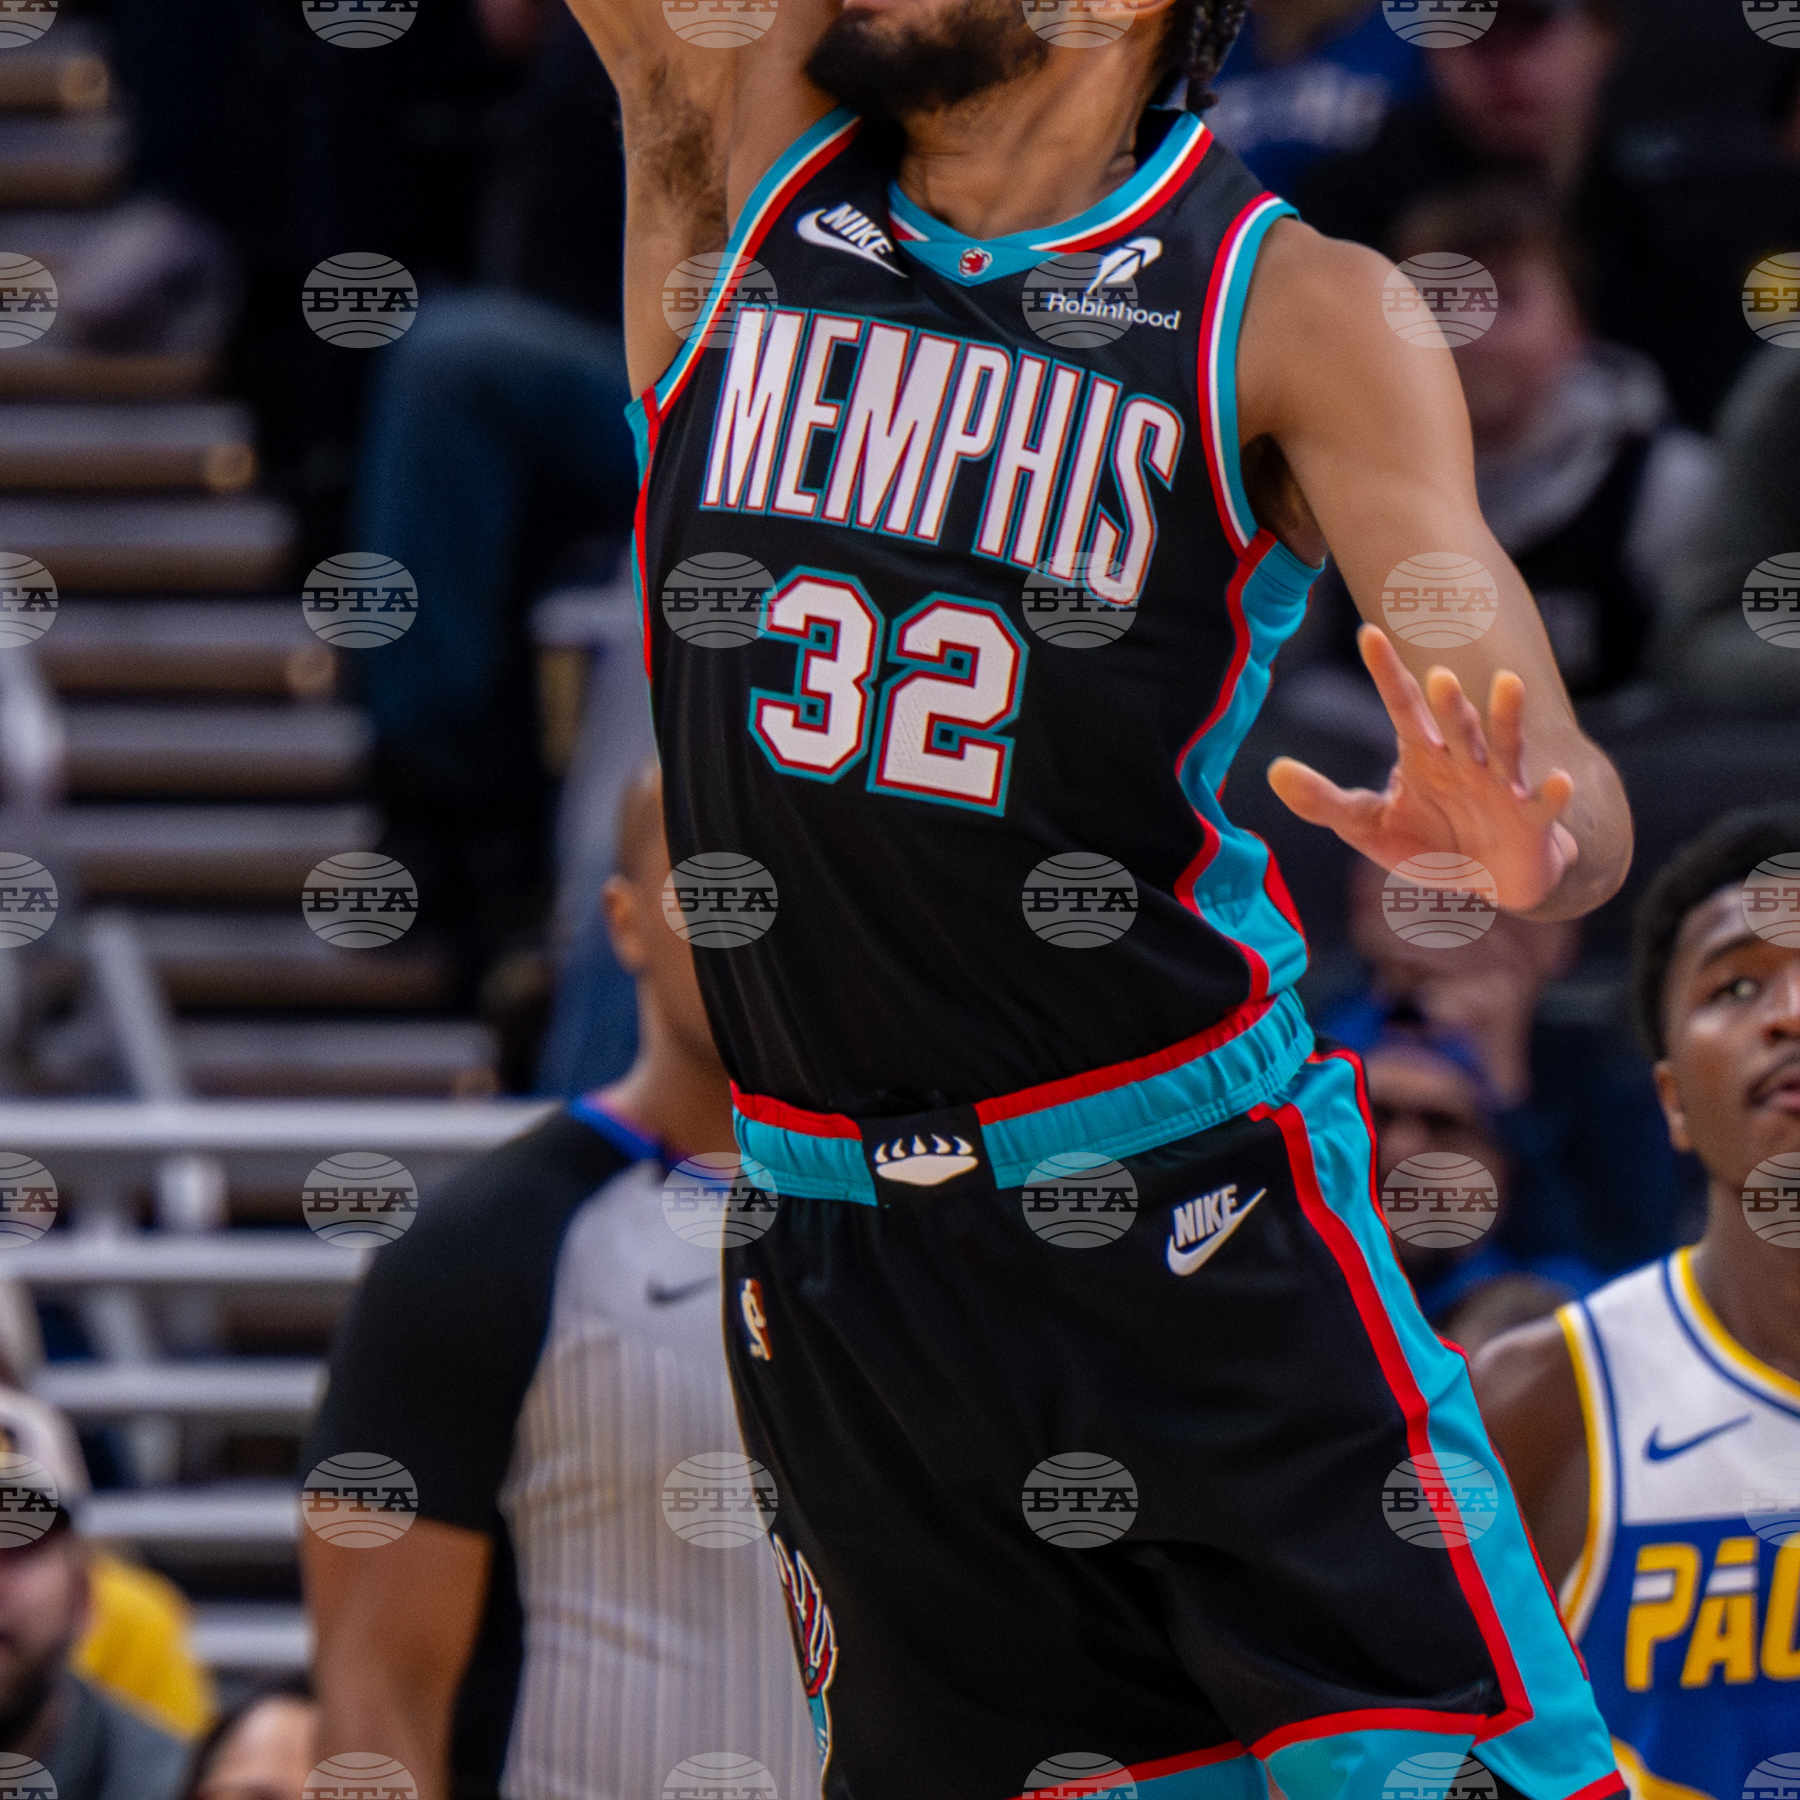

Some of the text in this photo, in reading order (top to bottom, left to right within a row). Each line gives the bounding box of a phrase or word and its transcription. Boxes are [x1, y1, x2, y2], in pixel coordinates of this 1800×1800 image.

[820, 201, 894, 255] NIKE
[1048, 291, 1182, 331] Robinhood
[700, 301, 1185, 610] MEMPHIS
[747, 564, 1030, 817] 32
[1173, 1183, 1238, 1249] NIKE
